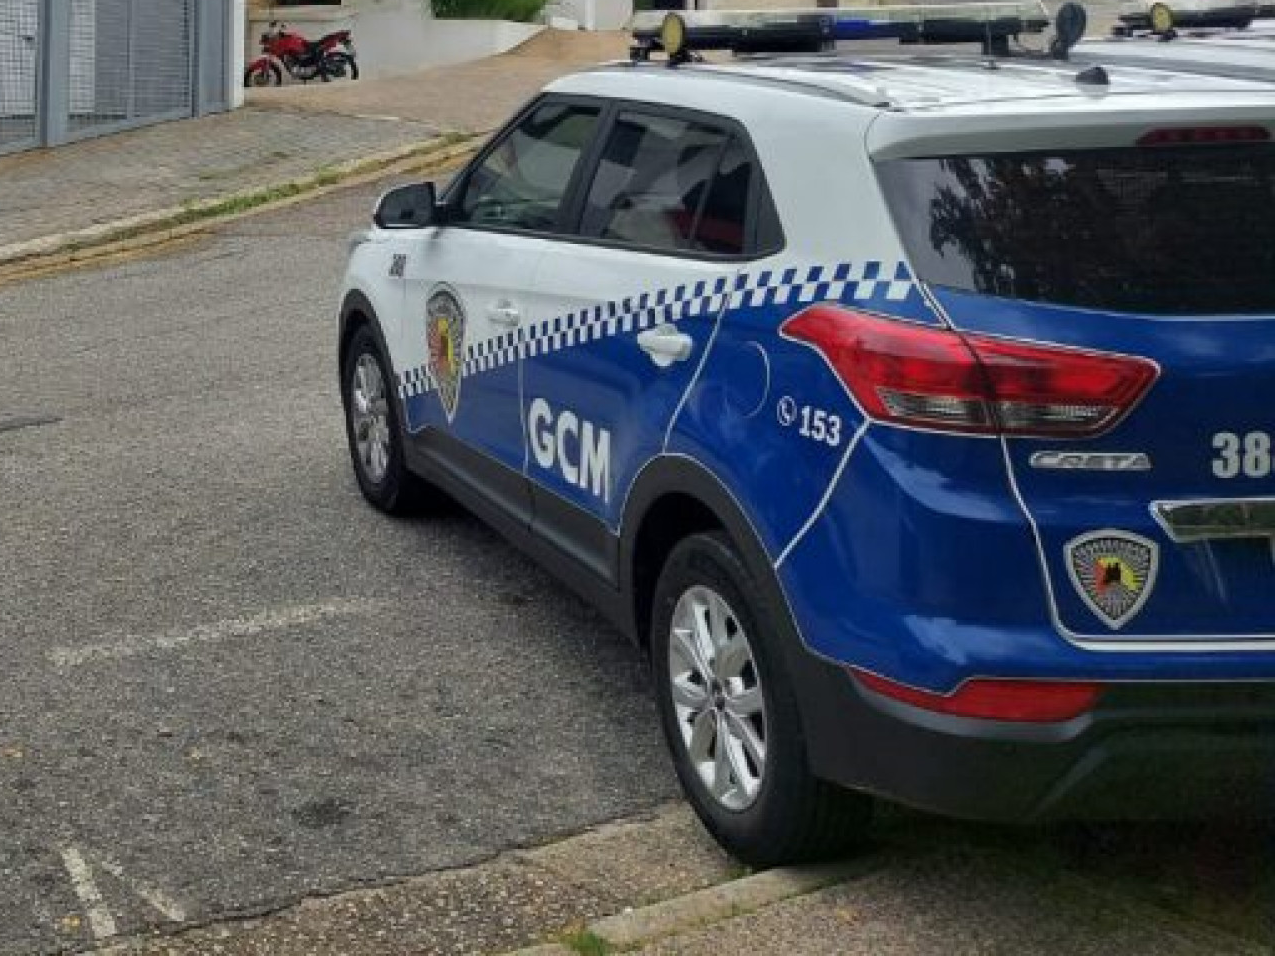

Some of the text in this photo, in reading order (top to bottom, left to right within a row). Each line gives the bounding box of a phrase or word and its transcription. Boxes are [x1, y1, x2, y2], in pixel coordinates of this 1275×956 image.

[799, 405, 842, 447] 153
[528, 397, 612, 504] GCM
[1212, 431, 1275, 479] 38
